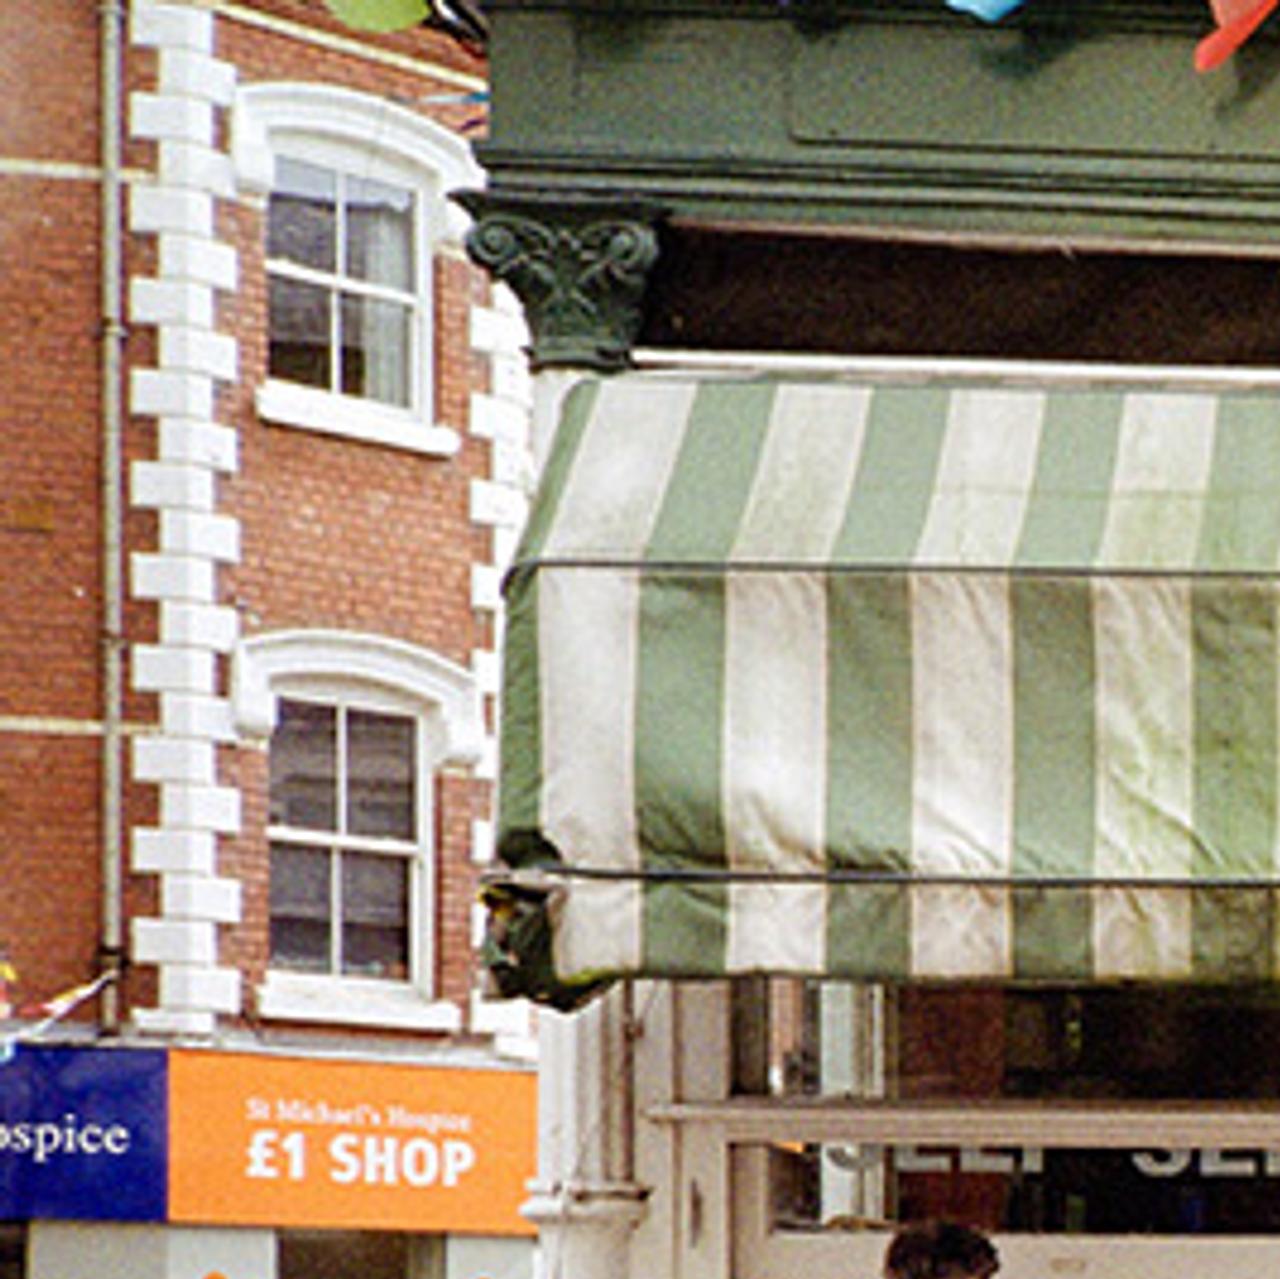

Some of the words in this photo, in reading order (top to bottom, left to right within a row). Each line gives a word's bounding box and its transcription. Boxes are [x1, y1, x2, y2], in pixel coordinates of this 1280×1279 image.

[245, 1098, 270, 1121] St
[276, 1099, 381, 1125] Michael's
[387, 1107, 471, 1133] Hospice
[246, 1130, 305, 1179] £1
[329, 1133, 475, 1187] SHOP
